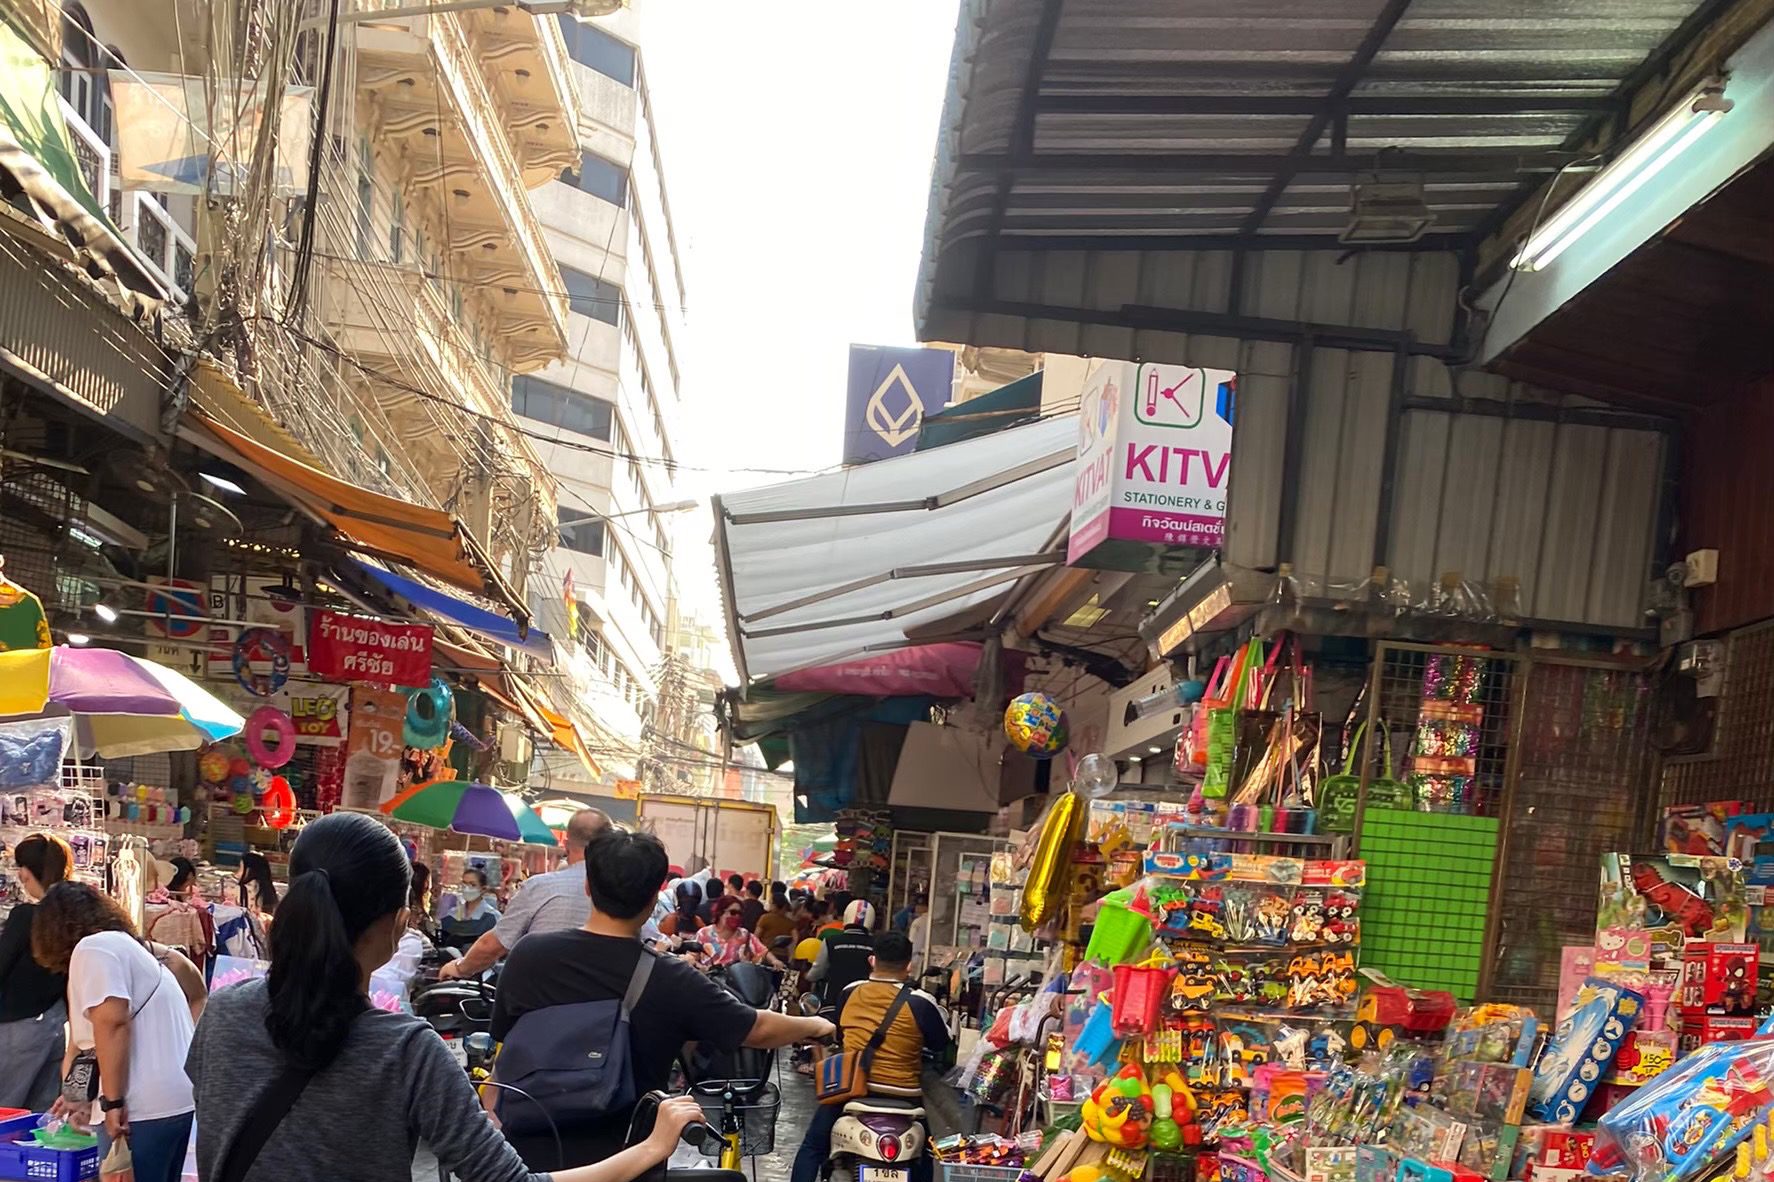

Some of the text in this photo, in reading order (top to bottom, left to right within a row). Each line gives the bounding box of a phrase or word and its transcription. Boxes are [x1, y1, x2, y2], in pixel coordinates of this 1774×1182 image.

[1124, 492, 1201, 509] STATIONERY
[1204, 501, 1212, 510] &
[319, 615, 425, 652] ร้านของเล่น
[343, 651, 394, 675] ศรีชัย
[291, 694, 337, 721] LEO
[298, 722, 331, 734] TOY
